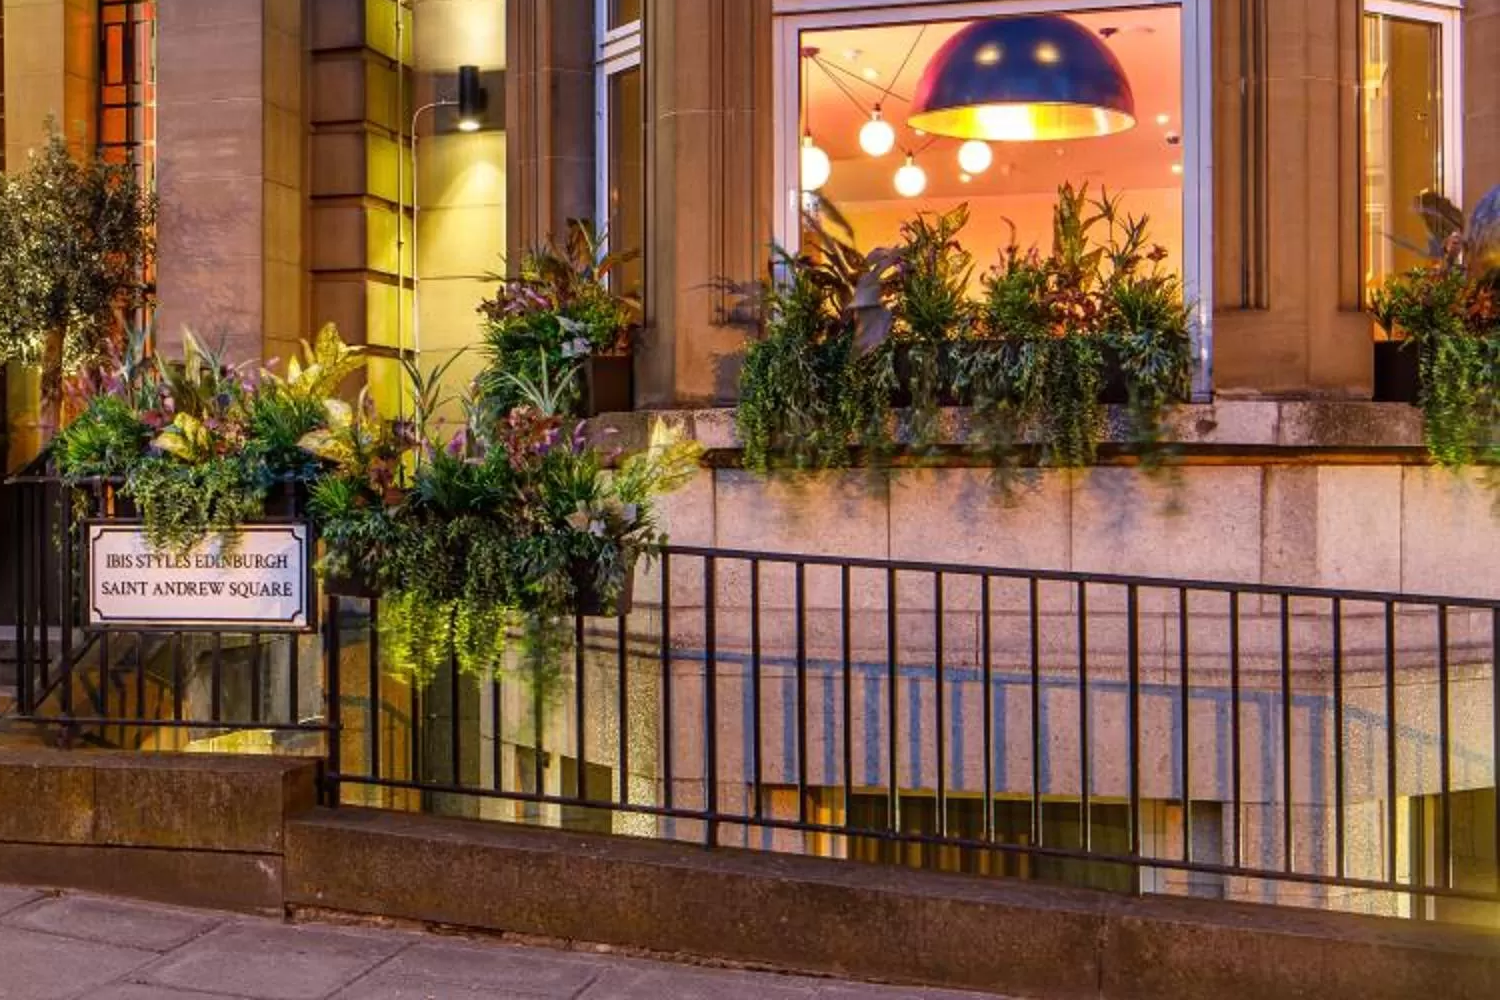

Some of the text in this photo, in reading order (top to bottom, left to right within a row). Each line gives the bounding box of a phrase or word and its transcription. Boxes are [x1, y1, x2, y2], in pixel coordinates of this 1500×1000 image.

[105, 552, 288, 569] IBIS STYLES EDINBURGH
[101, 581, 293, 600] SAINT ANDREW SQUARE
